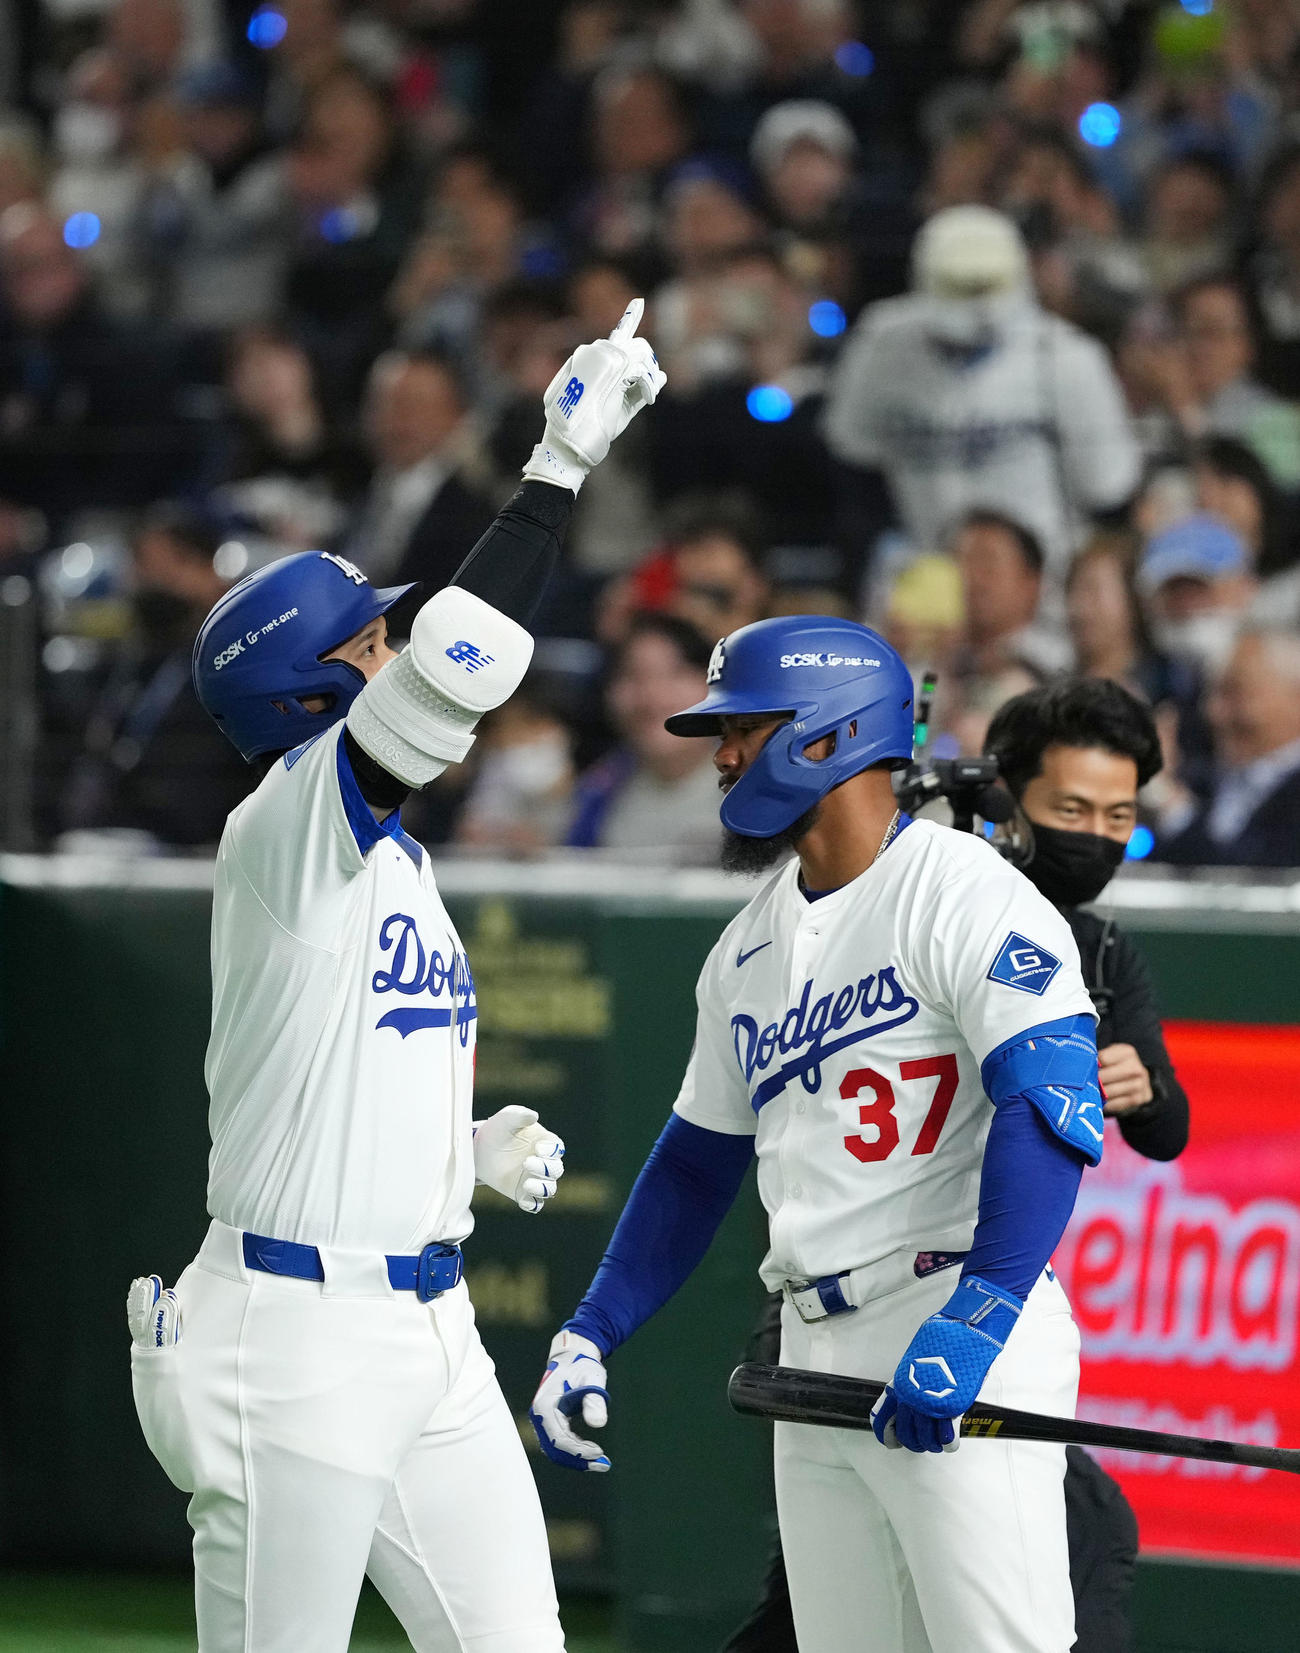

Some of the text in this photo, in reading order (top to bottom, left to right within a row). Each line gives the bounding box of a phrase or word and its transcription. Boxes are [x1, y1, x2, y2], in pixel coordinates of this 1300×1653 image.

[213, 638, 246, 671] SCSK
[780, 653, 824, 668] SCSK
[731, 966, 919, 1096] Dodgers
[839, 1053, 960, 1163] 37
[156, 1310, 164, 1329] new
